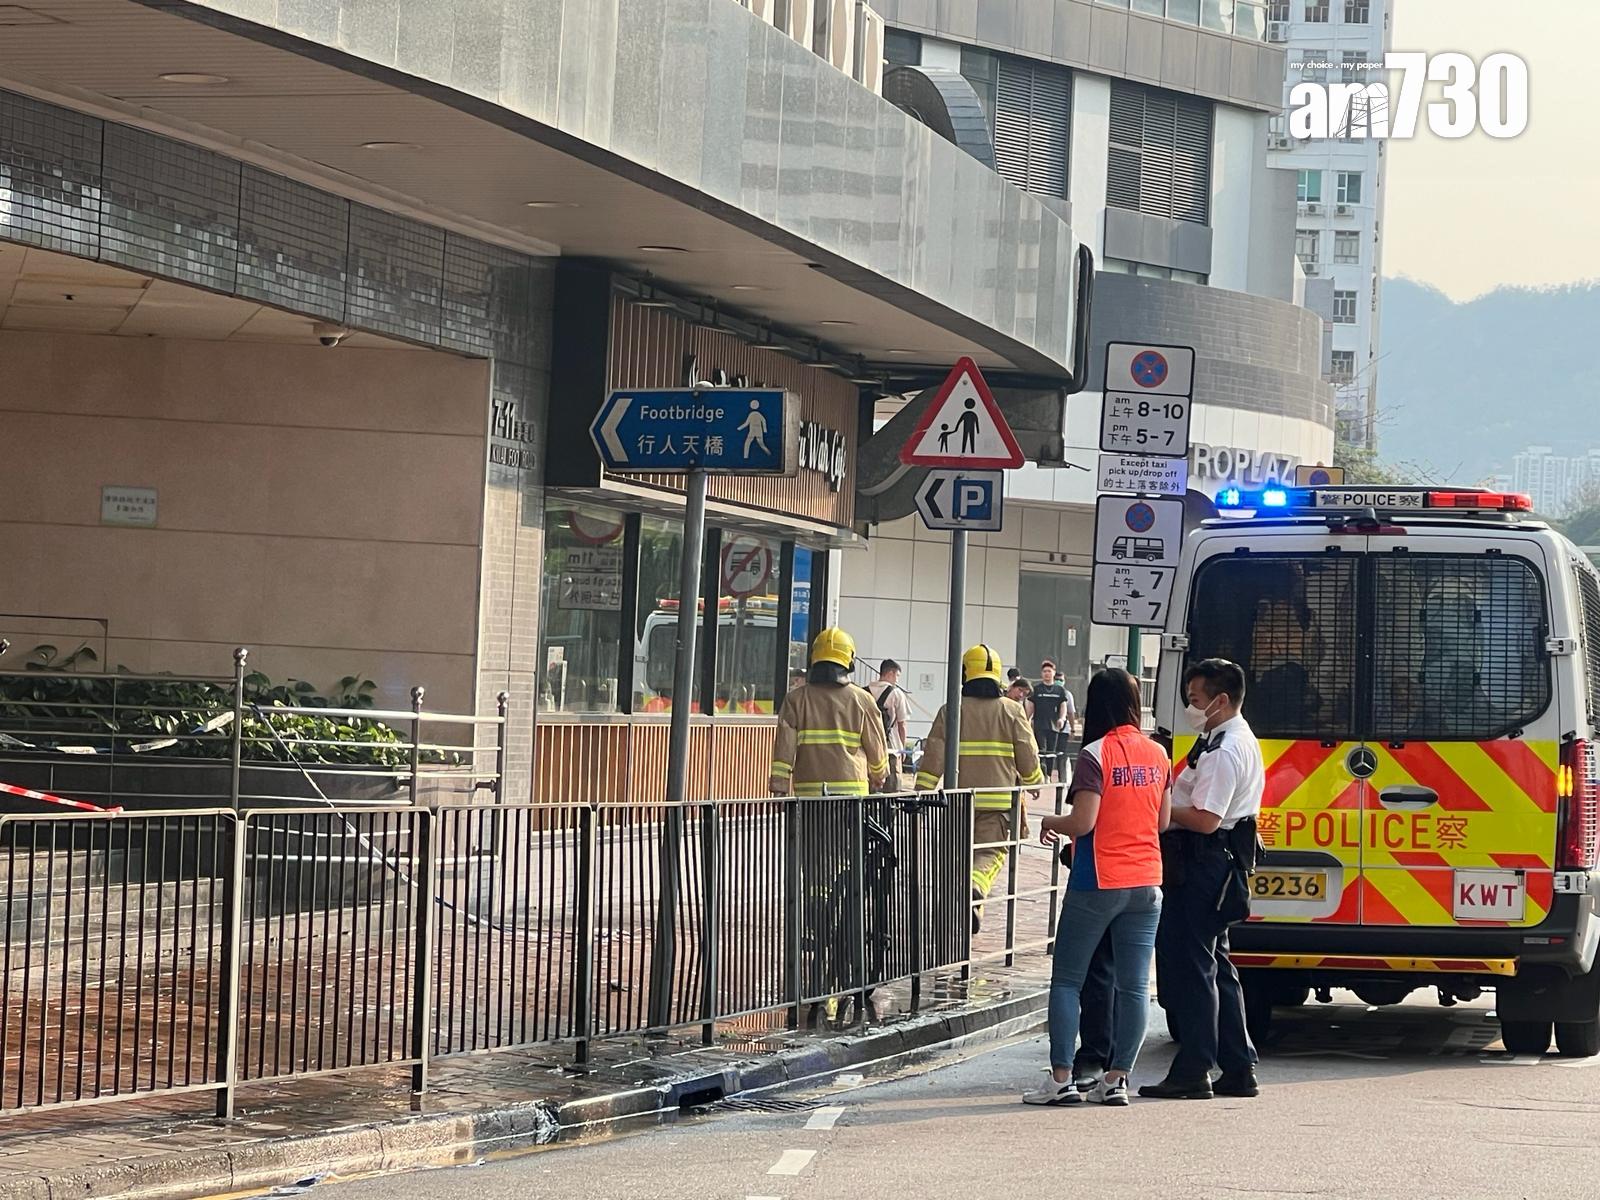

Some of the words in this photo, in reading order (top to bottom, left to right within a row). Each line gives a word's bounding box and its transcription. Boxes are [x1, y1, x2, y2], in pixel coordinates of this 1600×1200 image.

[640, 404, 725, 423] Footbridge
[1109, 405, 1134, 418] 上午
[1137, 401, 1184, 420] 8-10
[1112, 424, 1128, 432] pm
[637, 434, 724, 457] 行人天橋
[1107, 433, 1132, 445] 下午
[1108, 468, 1126, 476] pick
[1128, 469, 1163, 478] up/drop
[1165, 470, 1178, 478] off
[1120, 458, 1149, 468] Except
[1152, 460, 1168, 469] taxi
[1192, 443, 1297, 487] ROPLAZ
[1103, 478, 1180, 491] 的士上落客除外
[960, 485, 985, 516] P
[1343, 493, 1396, 506] POLICE
[1109, 576, 1134, 589] 上午
[1150, 571, 1164, 590] 7
[1115, 567, 1130, 575] am
[1107, 607, 1132, 620] 下午
[1148, 601, 1162, 620] 7
[1112, 598, 1129, 606] pm
[1285, 811, 1432, 849] POLICE
[1436, 814, 1469, 850] 察
[1254, 875, 1319, 897] 8236
[1460, 883, 1518, 907] KWT
